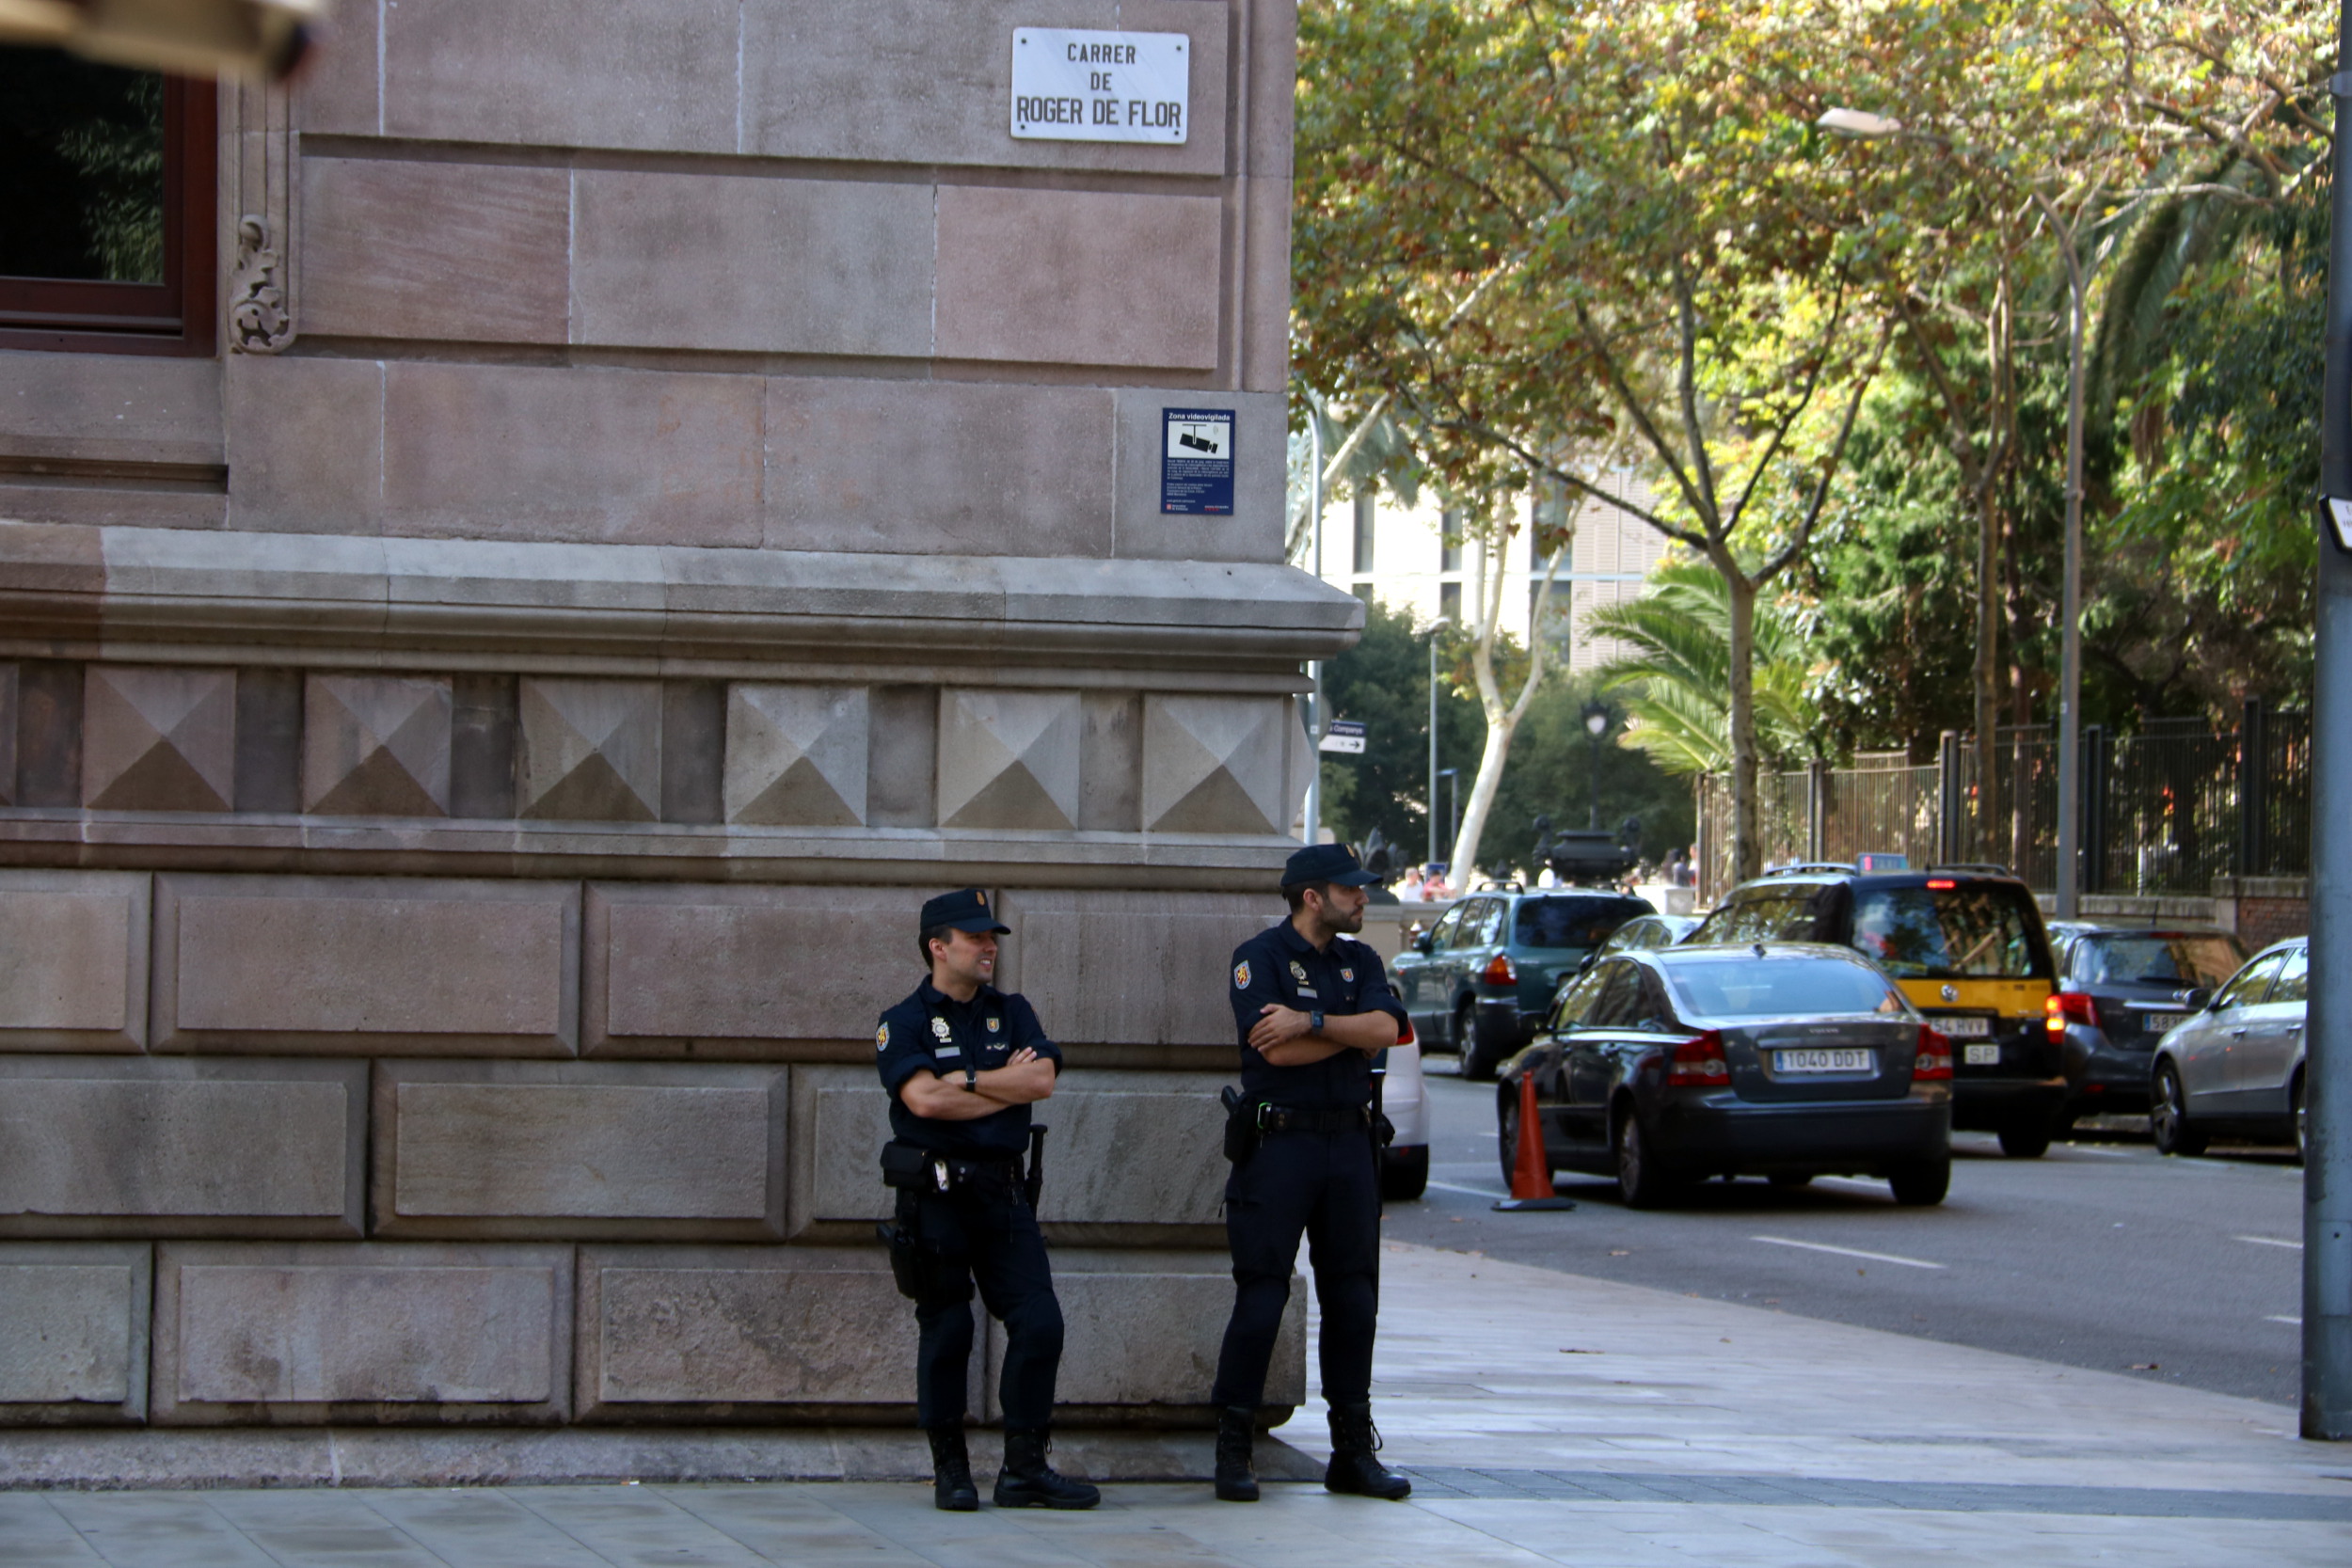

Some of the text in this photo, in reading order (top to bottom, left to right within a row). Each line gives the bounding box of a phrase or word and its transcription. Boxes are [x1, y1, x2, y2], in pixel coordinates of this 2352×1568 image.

[1067, 42, 1136, 64] CARRER
[1090, 71, 1112, 91] DE
[1016, 95, 1182, 128] ROGER DE FLOR
[1186, 413, 1231, 421] videovigilada
[1334, 724, 1363, 735] Companys
[2153, 1016, 2185, 1029] 583
[1788, 1052, 1828, 1068] 1040
[1969, 1046, 1994, 1063] SP
